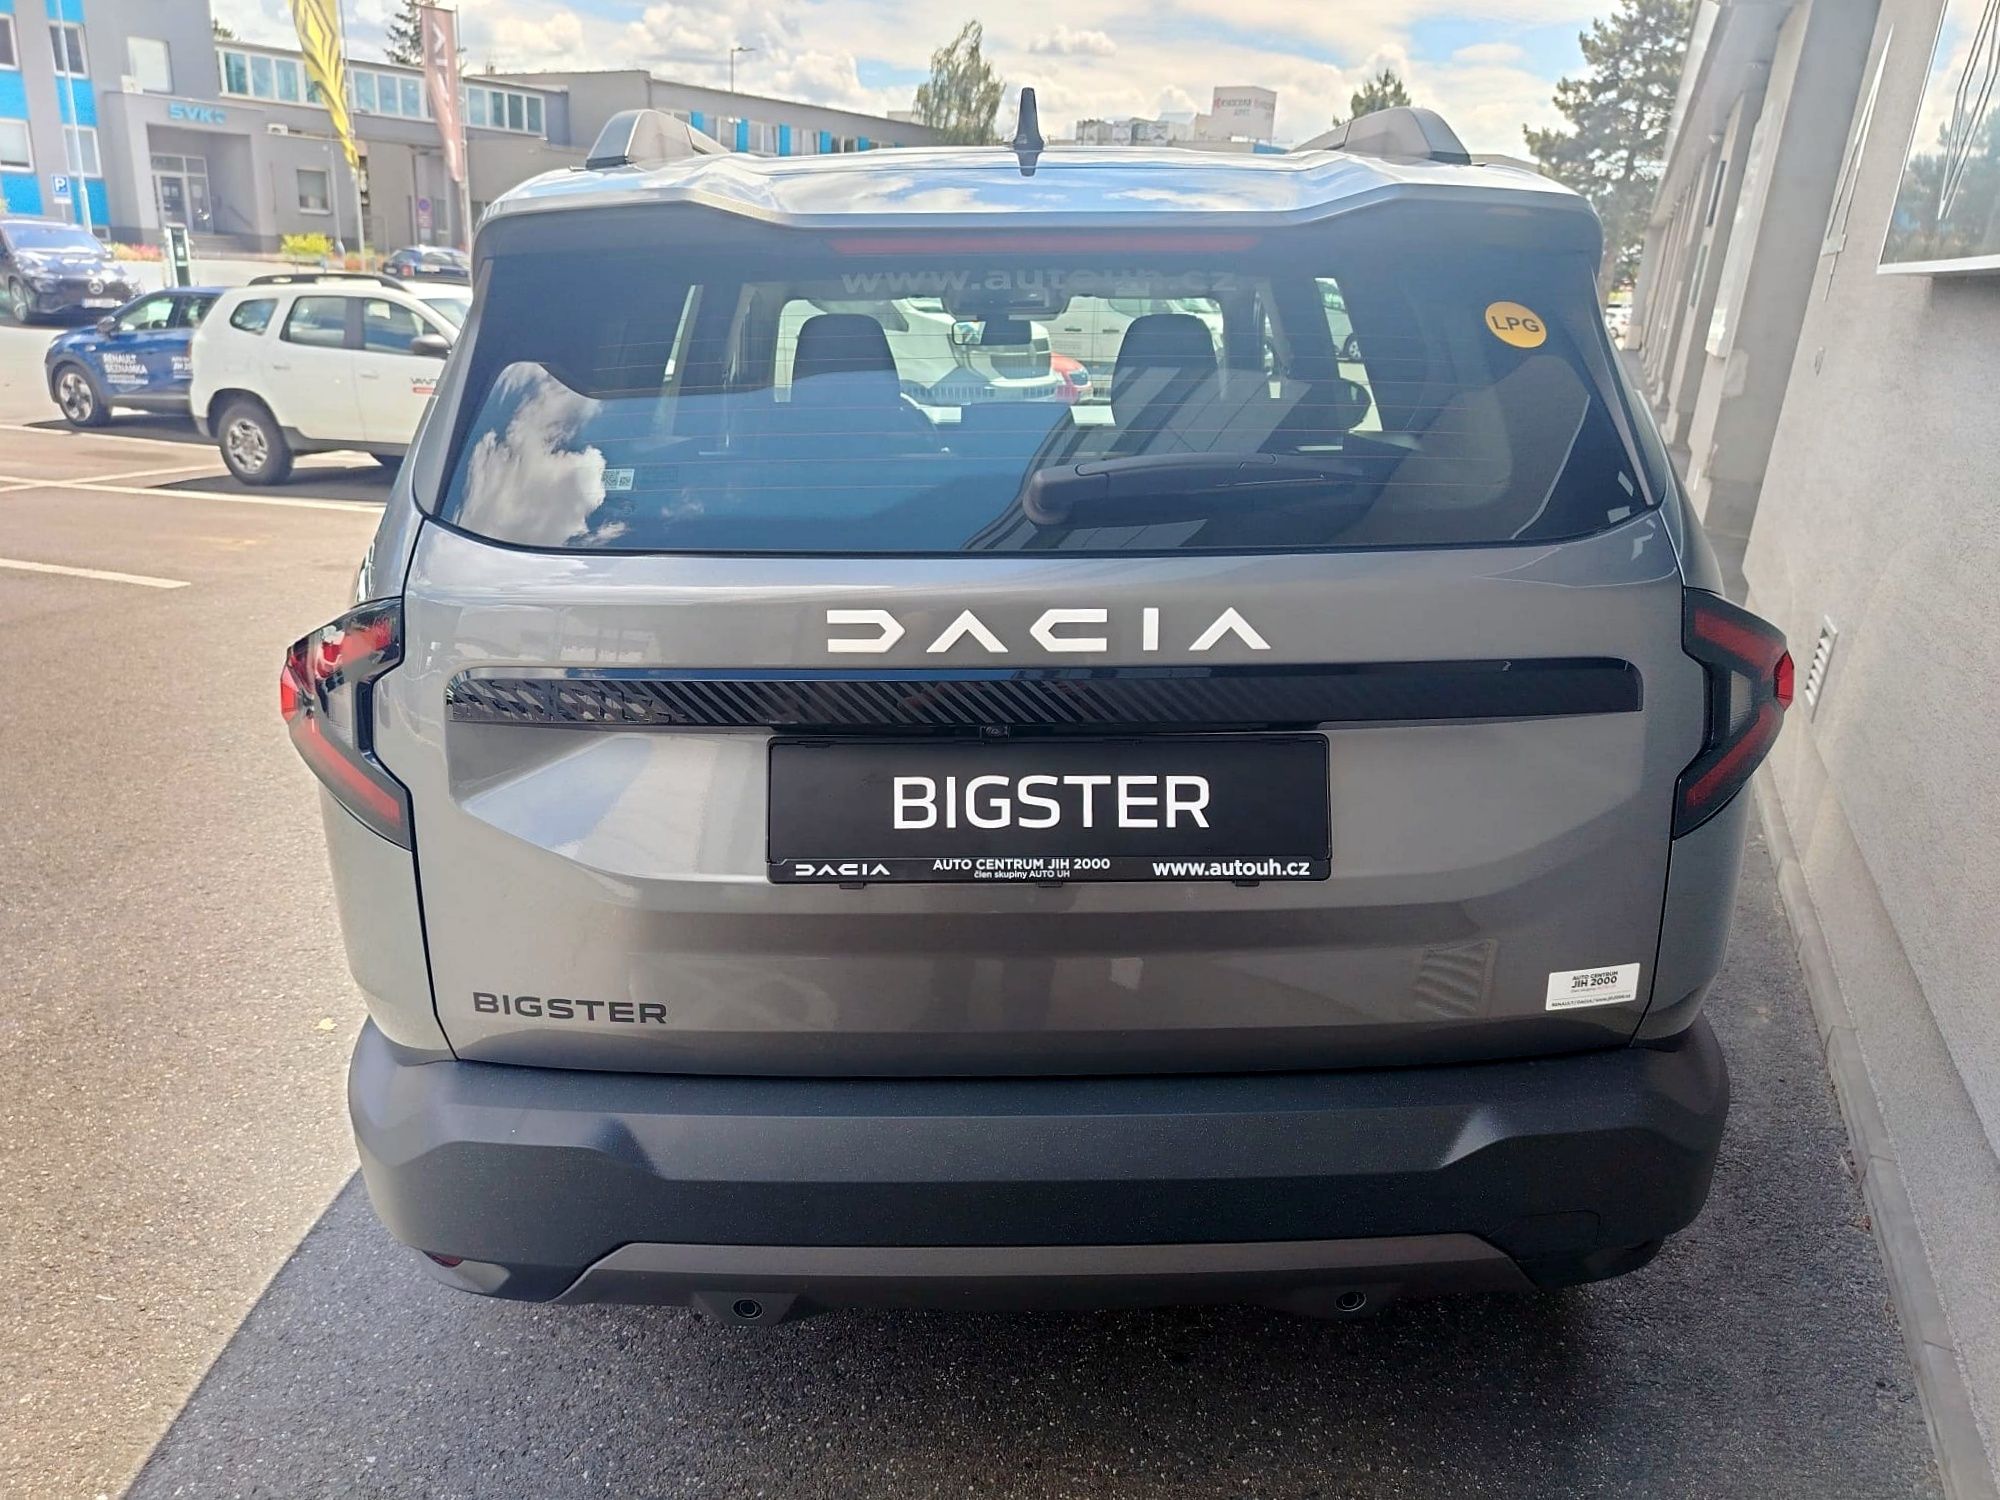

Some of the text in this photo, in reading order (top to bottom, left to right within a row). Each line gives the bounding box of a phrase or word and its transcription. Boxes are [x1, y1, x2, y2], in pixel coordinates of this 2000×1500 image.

[55, 178, 66, 191] P
[1491, 316, 1540, 332] LPG
[827, 607, 1271, 652] DACIA
[892, 774, 1210, 829] BIGSTER
[795, 864, 891, 876] DACIA
[932, 858, 1111, 870] AUTO CENTRUM JIH 2000
[1152, 859, 1310, 876] www.autouh.cz
[974, 869, 1071, 879] člen skupiny AUTO UH
[1590, 971, 1619, 979] CENTRUM
[1571, 976, 1618, 988] JIH 2000
[473, 991, 667, 1024] BIGSTER
